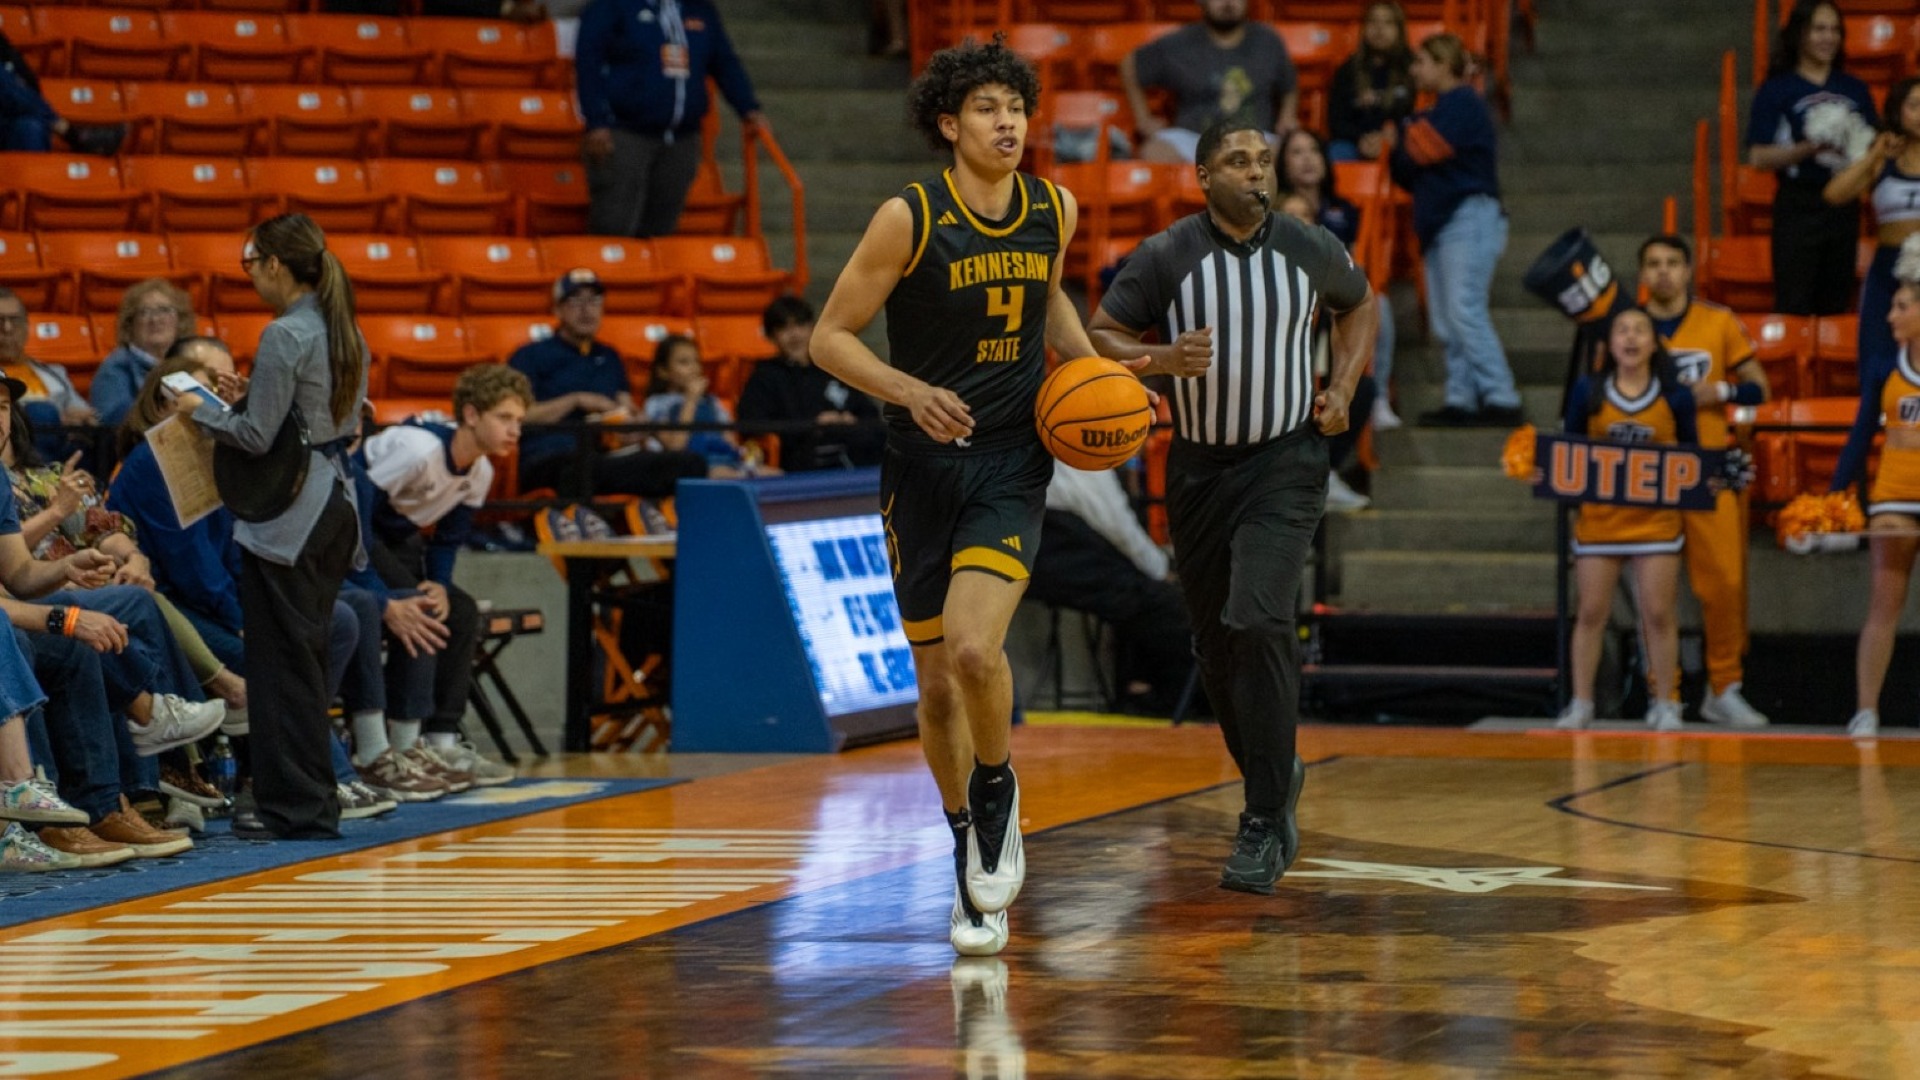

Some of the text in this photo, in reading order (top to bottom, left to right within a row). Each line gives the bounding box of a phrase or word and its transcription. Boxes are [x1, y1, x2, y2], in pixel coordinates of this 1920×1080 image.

[948, 251, 1049, 291] KENNESAW
[985, 285, 1026, 333] 4
[976, 337, 1022, 363] STATE
[1081, 423, 1148, 448] Wilson
[1550, 441, 1702, 505] UTEP
